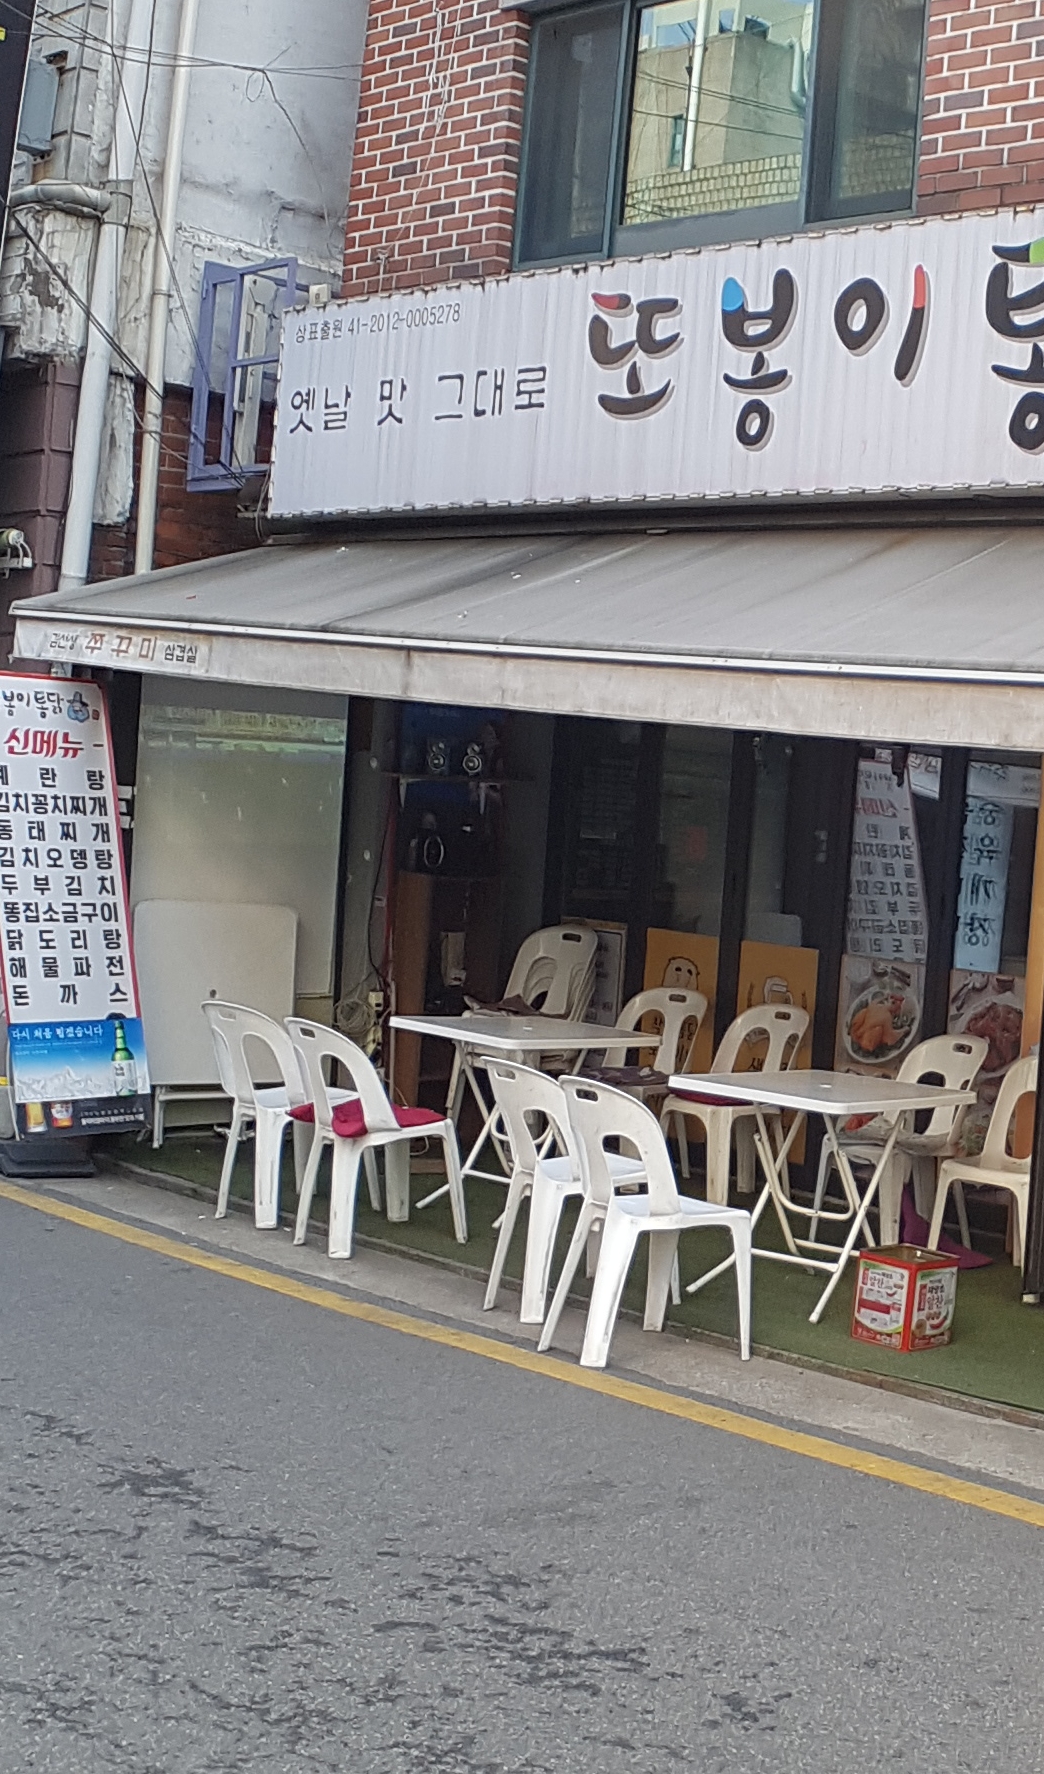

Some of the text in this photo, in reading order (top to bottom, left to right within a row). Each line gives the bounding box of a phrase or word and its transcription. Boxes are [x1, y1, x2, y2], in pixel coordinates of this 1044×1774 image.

[295, 302, 461, 344] 상표출원 41-2012-0005278
[289, 365, 548, 435] 옛날 맛 그대로
[4, 728, 85, 758] 신메뉴
[4, 901, 119, 924] 똥집소금구이
